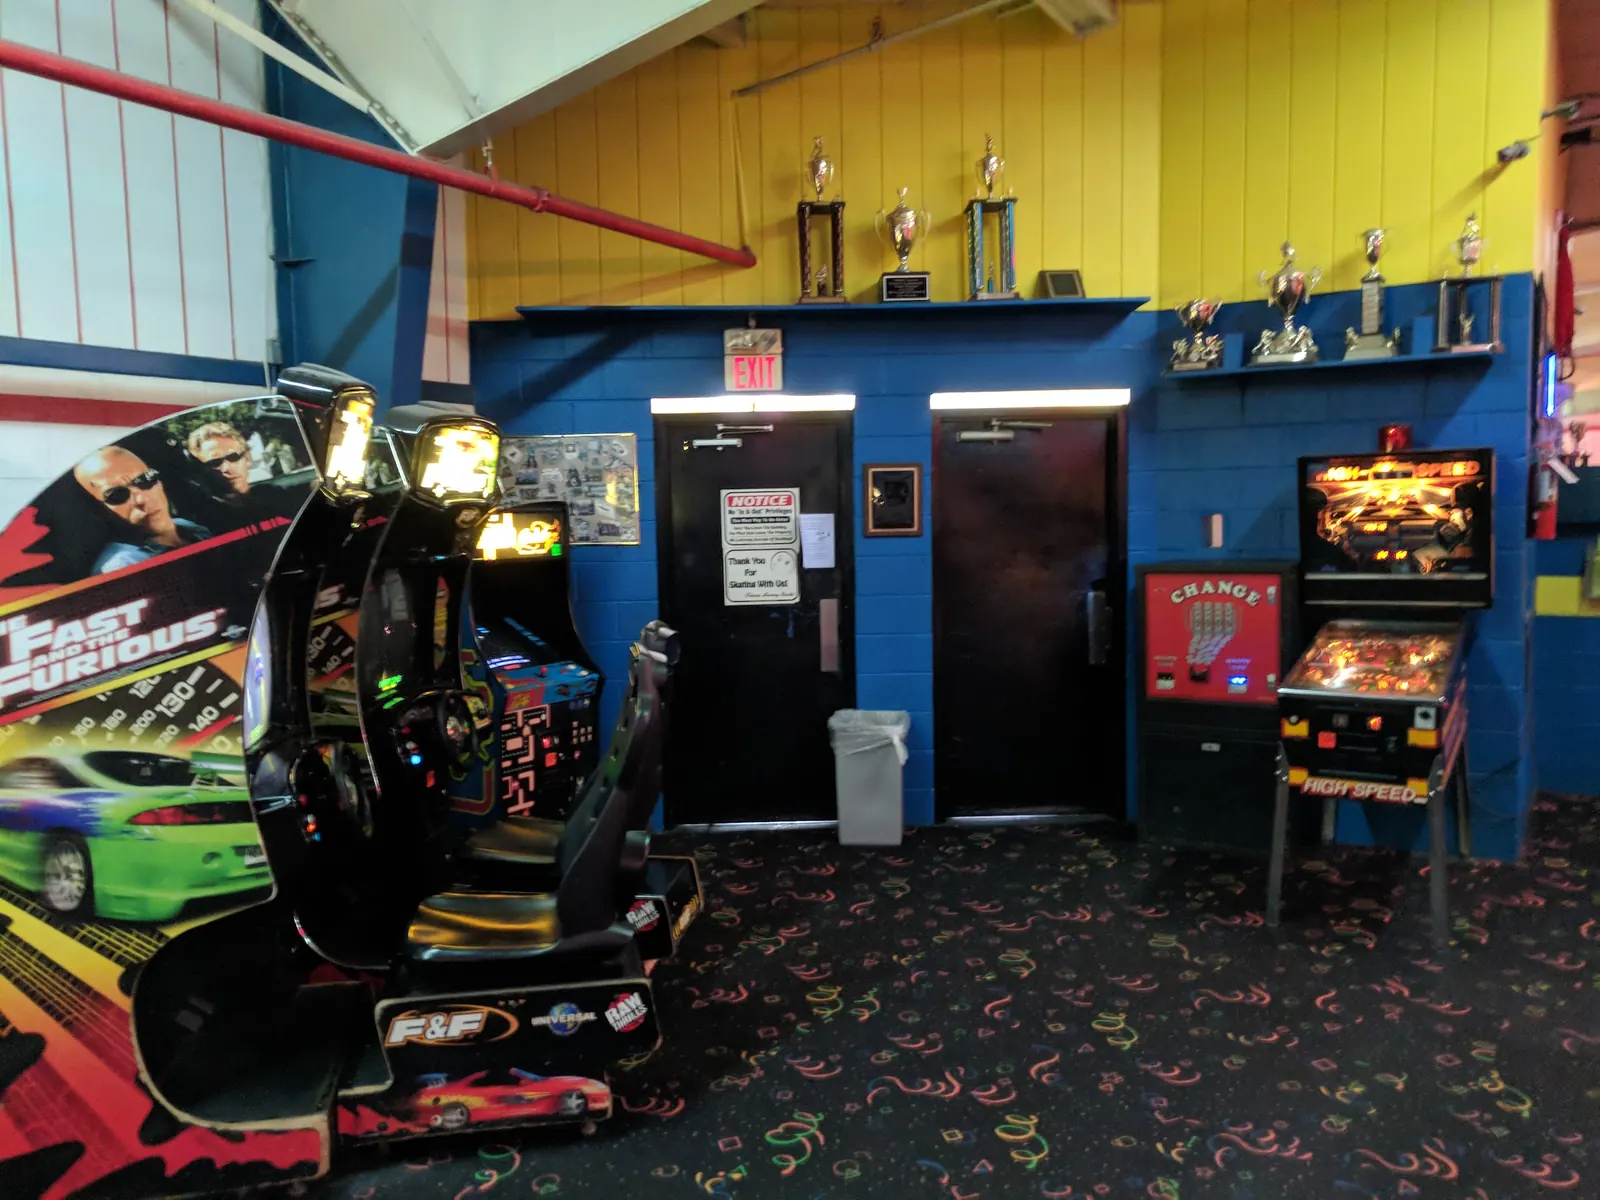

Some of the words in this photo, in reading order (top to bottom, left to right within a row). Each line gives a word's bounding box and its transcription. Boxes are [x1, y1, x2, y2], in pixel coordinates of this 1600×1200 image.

[734, 357, 776, 389] EXIT
[731, 495, 789, 507] NOTICE
[728, 557, 750, 566] Thank
[752, 557, 766, 565] You
[744, 569, 757, 577] For
[728, 580, 756, 589] Skating
[757, 580, 774, 588] With
[1170, 580, 1262, 607] CHANGE
[10, 598, 149, 663] FAST
[32, 643, 83, 669] AND
[84, 627, 130, 651] THE
[188, 705, 220, 732] 140
[1303, 778, 1348, 795] HIGH
[1353, 783, 1417, 802] SPEED
[388, 1012, 484, 1043] F&F
